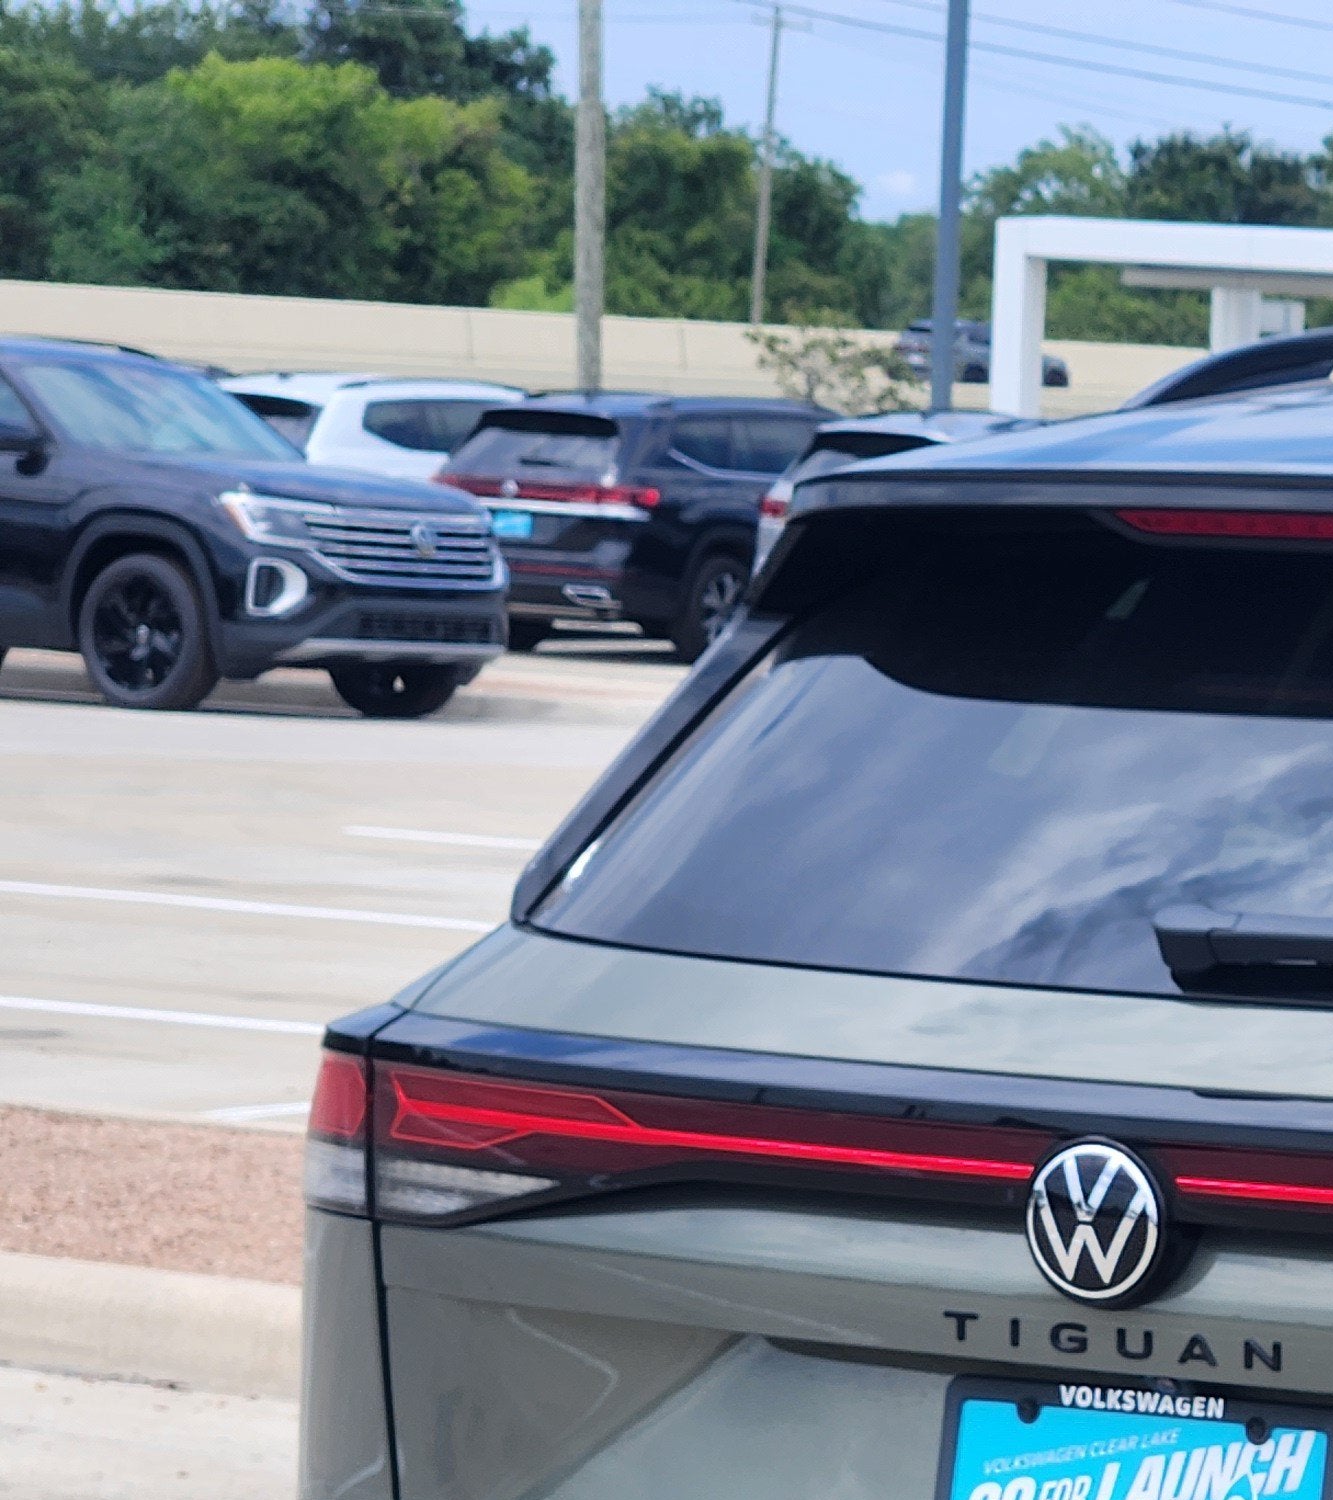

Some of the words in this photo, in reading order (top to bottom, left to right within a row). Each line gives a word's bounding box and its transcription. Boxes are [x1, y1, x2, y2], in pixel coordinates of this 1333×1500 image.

[942, 1309, 1284, 1372] TIGUAN
[1059, 1383, 1226, 1419] VOLKSWAGEN
[982, 1444, 1087, 1476] VOLKSWAGEN
[1089, 1435, 1140, 1459] CLEAR
[1141, 1427, 1182, 1449] LAKE
